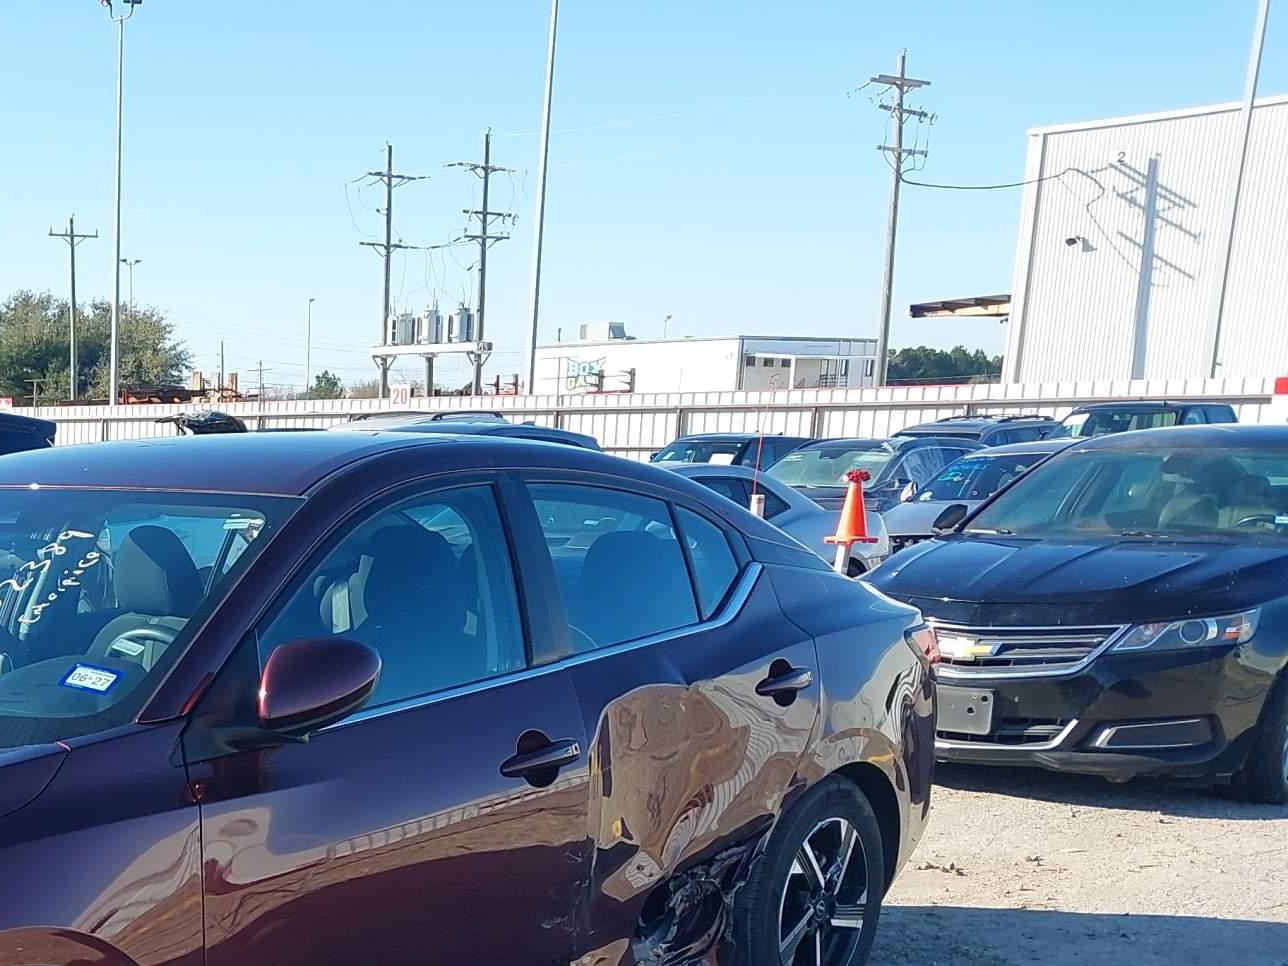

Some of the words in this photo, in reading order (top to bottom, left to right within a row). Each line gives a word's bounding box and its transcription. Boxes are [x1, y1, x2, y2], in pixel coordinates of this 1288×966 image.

[1116, 151, 1127, 163] 2
[567, 358, 604, 378] BOX
[392, 387, 409, 405] 20
[71, 672, 89, 682] 06
[91, 676, 111, 687] 27
